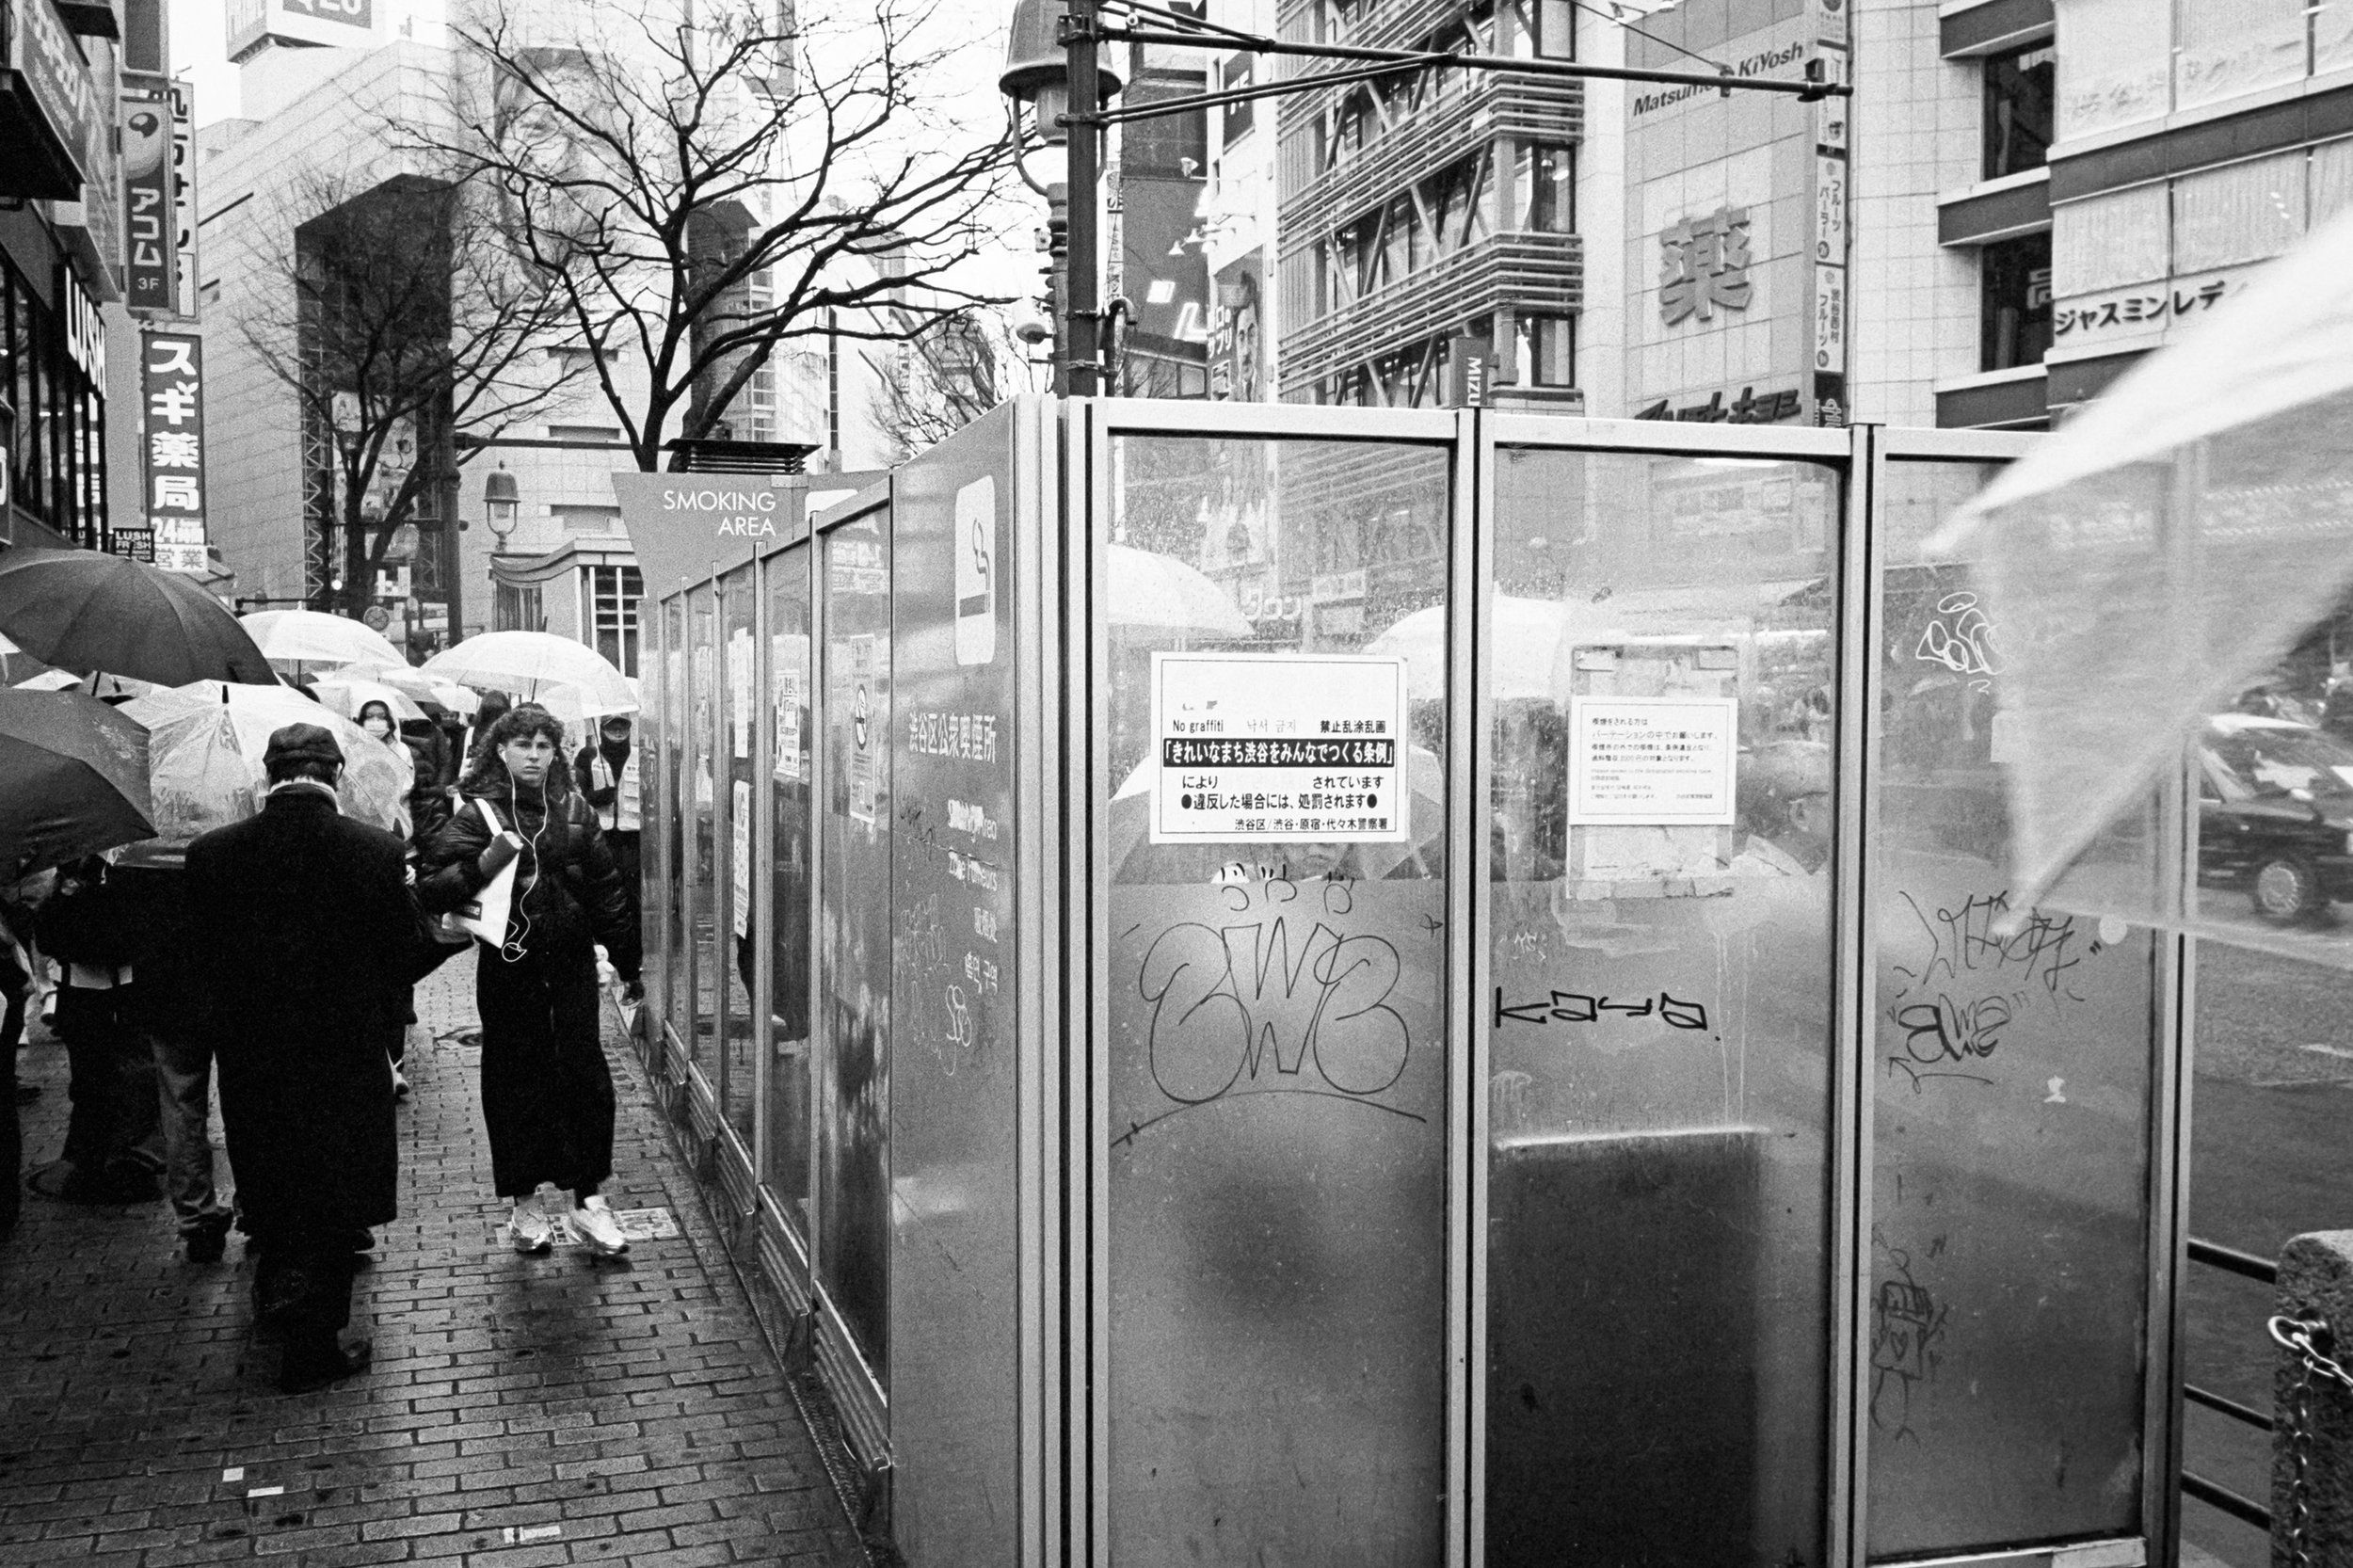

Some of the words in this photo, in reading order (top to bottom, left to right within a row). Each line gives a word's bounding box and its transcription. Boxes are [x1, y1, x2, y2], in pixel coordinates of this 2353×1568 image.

[1738, 41, 1803, 77] KiYosh
[131, 187, 163, 267] アコム
[137, 277, 161, 291] 3F
[2055, 280, 2228, 337] ジャスミンレデ
[65, 266, 107, 400] LUSH
[149, 340, 200, 511] スギ薬局
[663, 489, 776, 512] SMOKING
[115, 530, 152, 541] LUSH
[718, 517, 776, 536] AREA
[1173, 719, 1186, 732] No
[1189, 718, 1225, 734] graffiti
[1165, 741, 1394, 764] 「きれいなまち渋谷をみんなでつくる条例」
[1181, 775, 1219, 790] により
[1312, 775, 1385, 790] されています
